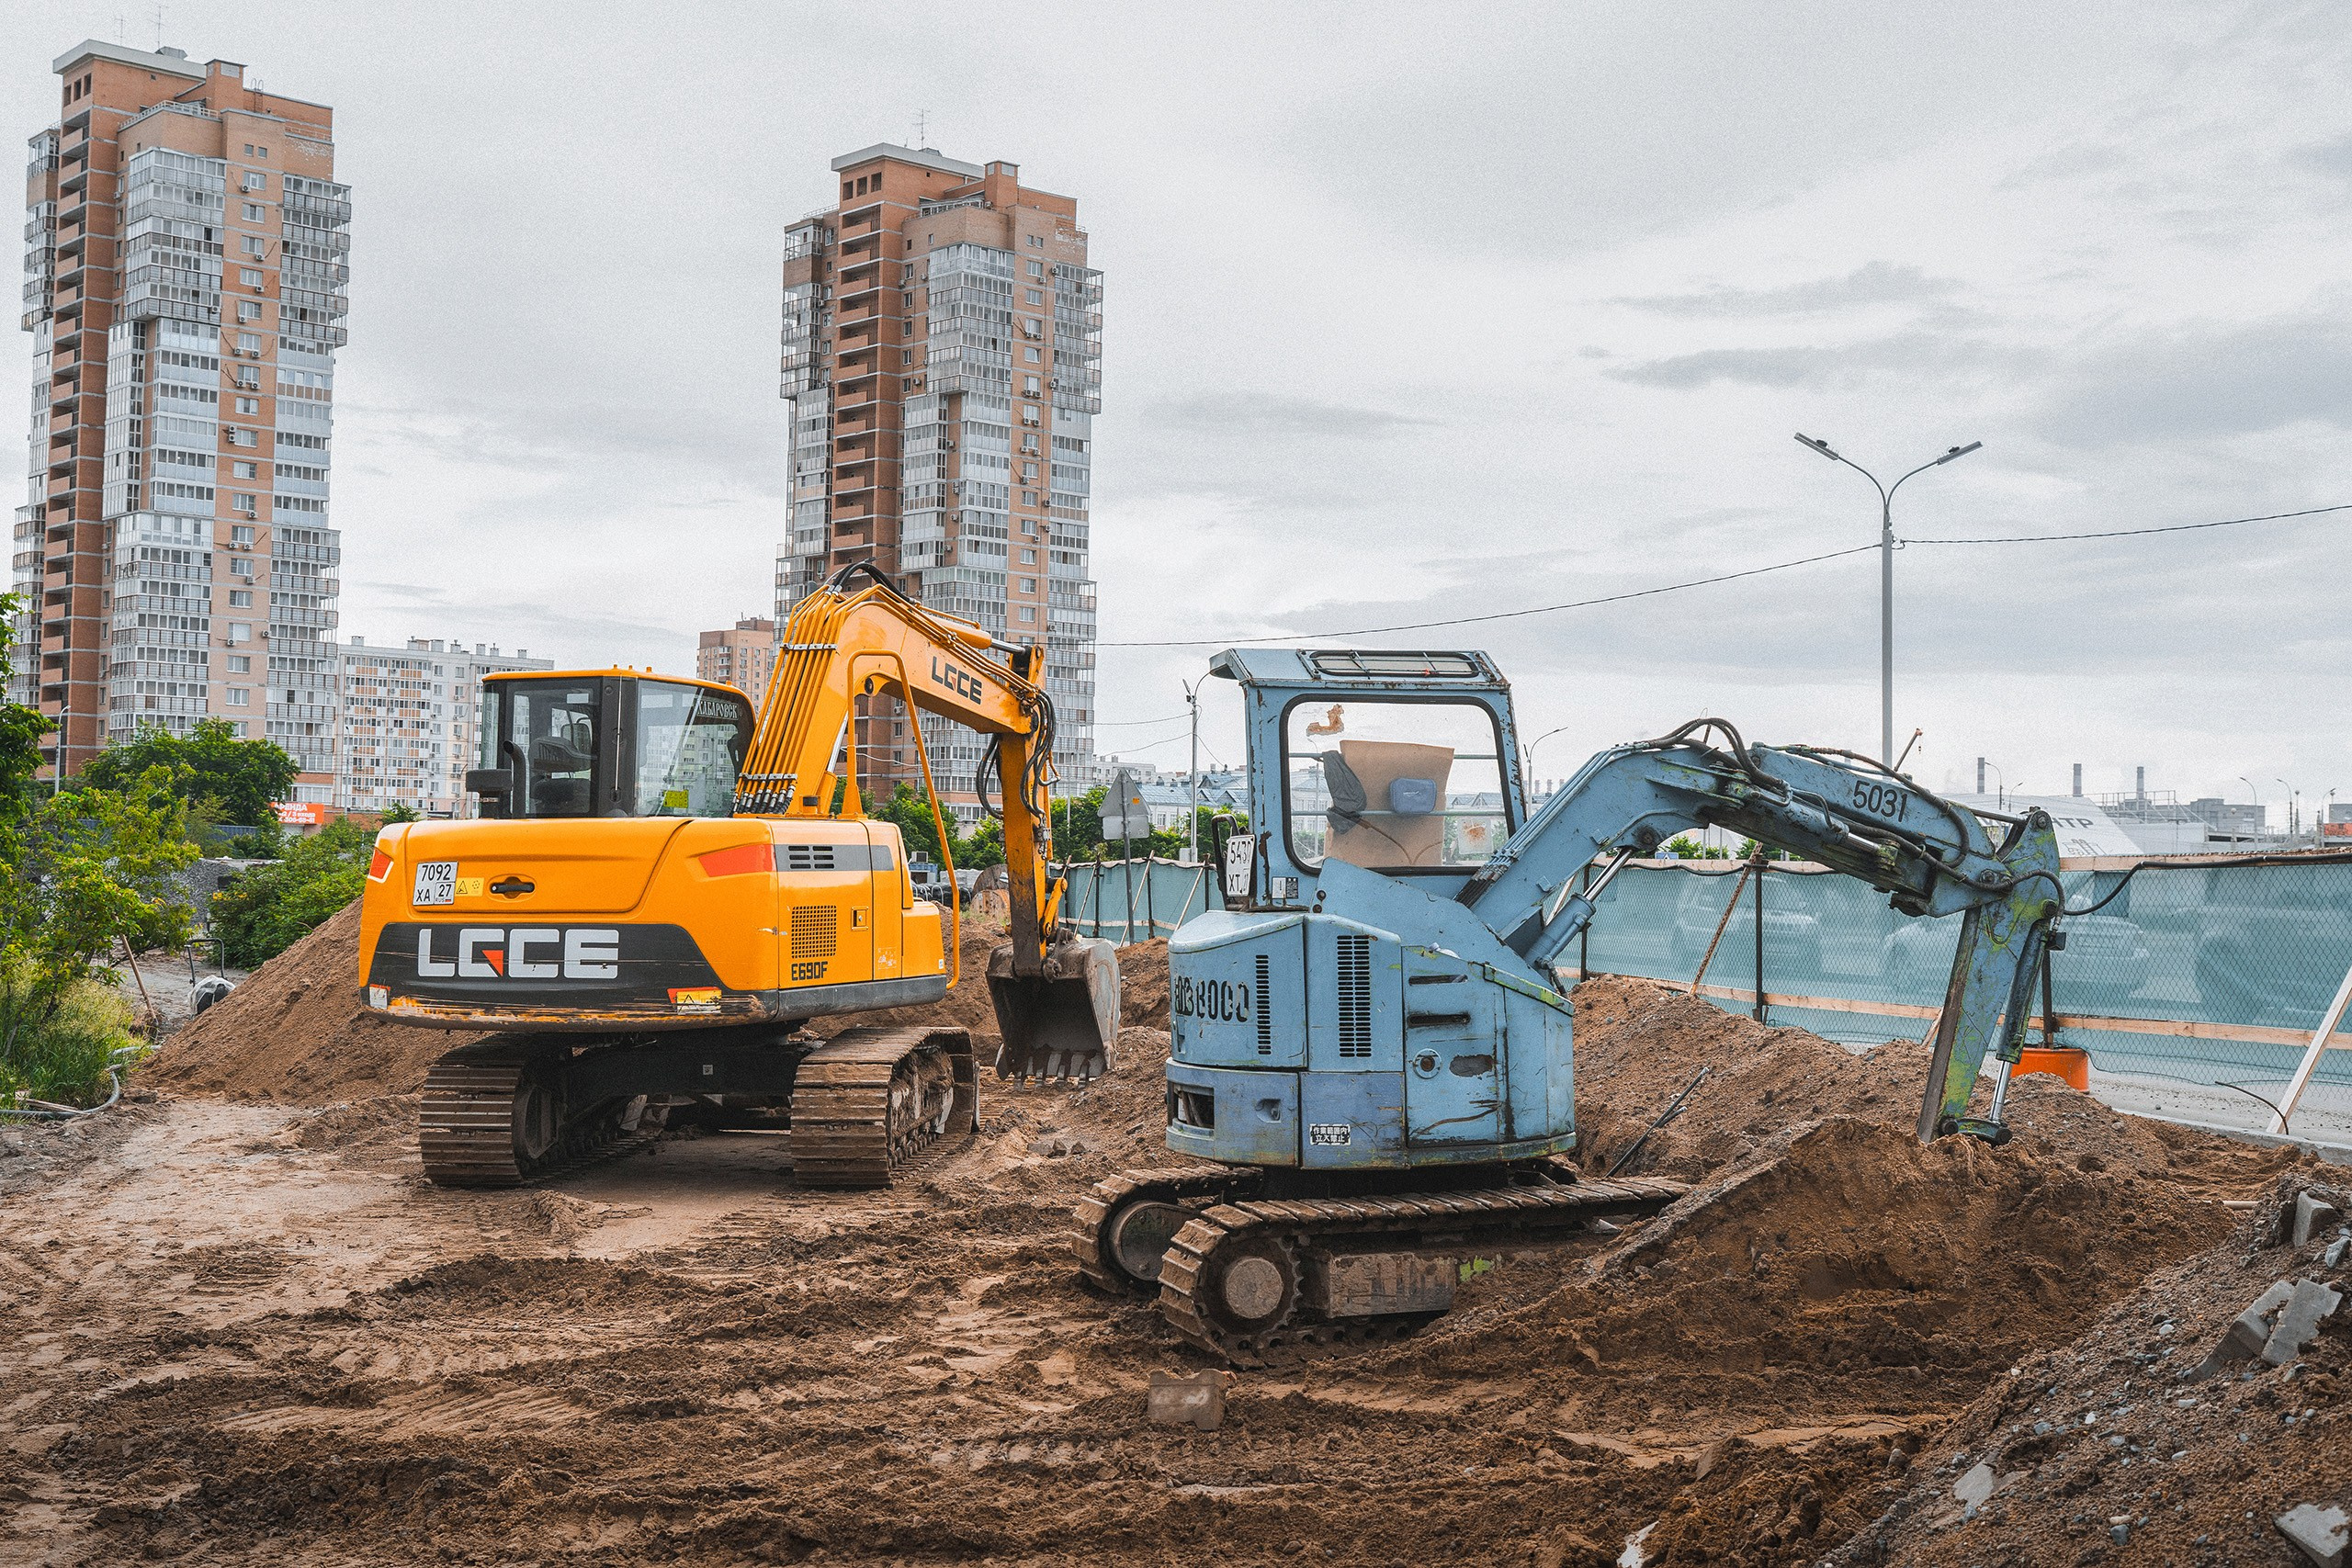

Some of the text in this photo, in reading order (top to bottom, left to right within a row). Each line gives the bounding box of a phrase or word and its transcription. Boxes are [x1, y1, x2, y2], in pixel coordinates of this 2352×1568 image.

[697, 701, 738, 718] ХАБАРОВСК
[1853, 780, 1907, 822] 5031
[422, 864, 451, 881] 7092
[438, 885, 451, 897] 27
[791, 961, 829, 981] E690F
